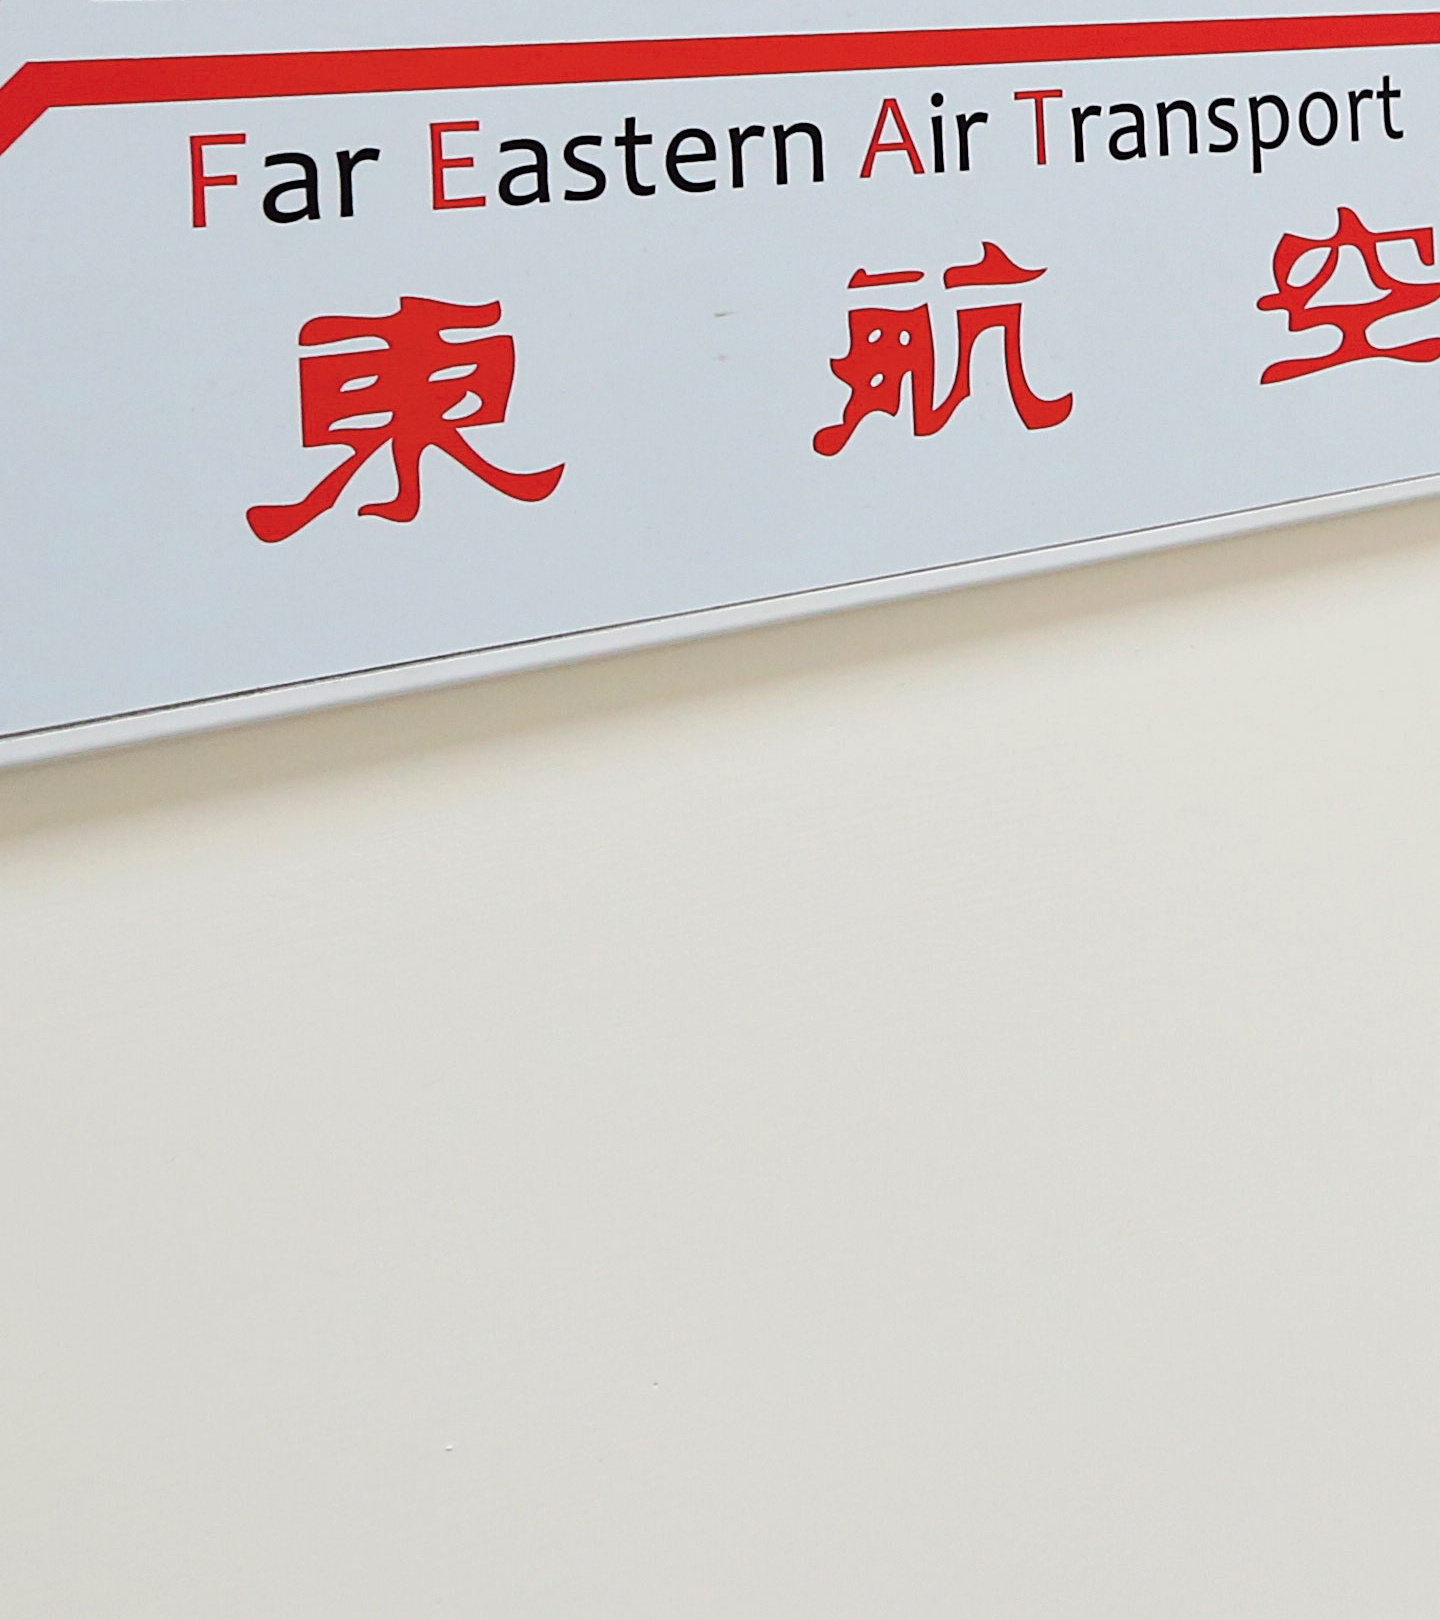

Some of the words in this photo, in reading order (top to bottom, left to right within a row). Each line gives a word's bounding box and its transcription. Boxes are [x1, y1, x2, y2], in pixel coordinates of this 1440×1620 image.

[191, 133, 381, 228] Far
[430, 116, 824, 210] Eastern
[860, 92, 989, 179] Air
[1014, 75, 1404, 174] Transport
